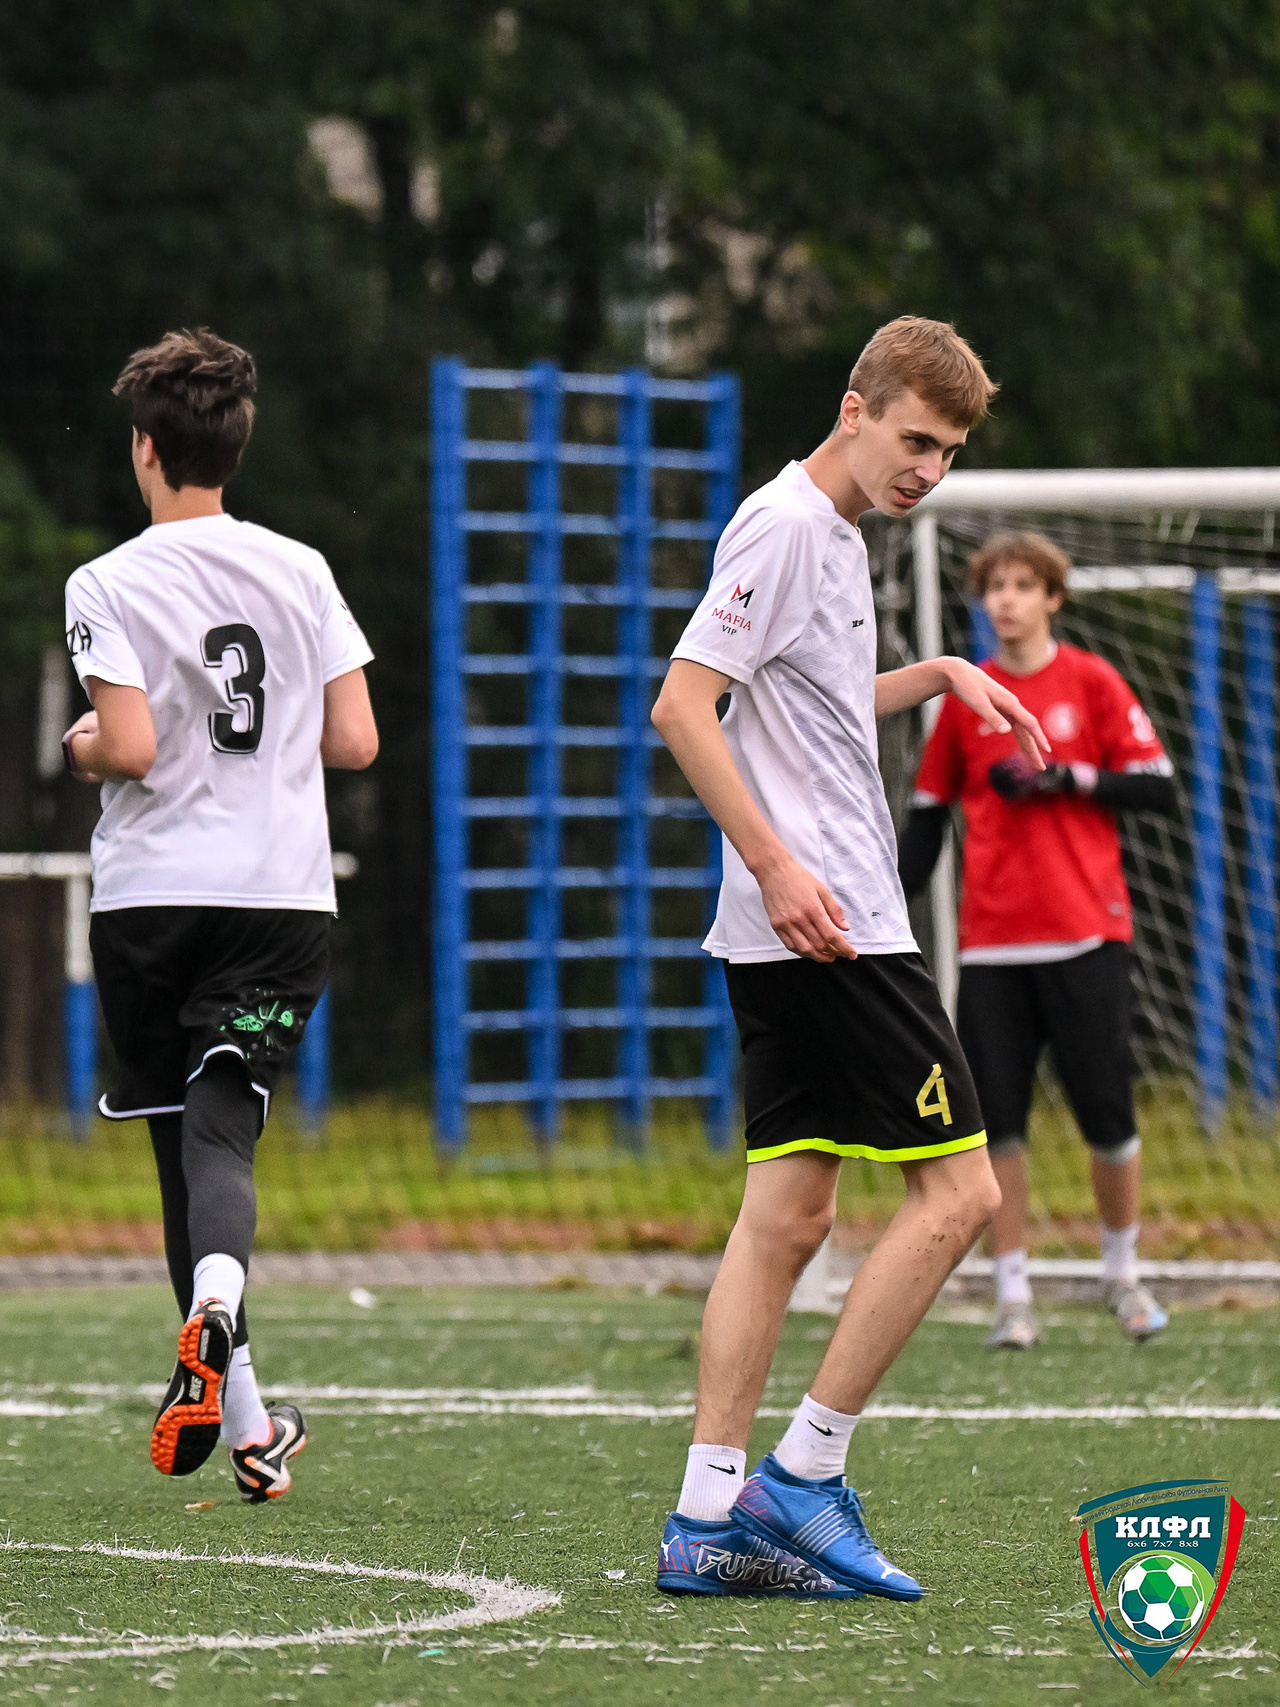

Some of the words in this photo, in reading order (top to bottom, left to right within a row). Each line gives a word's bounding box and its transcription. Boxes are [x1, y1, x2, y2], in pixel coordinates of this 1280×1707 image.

[711, 607, 751, 631] MAFIA
[722, 624, 737, 635] VIP
[200, 623, 265, 754] 3
[915, 1063, 953, 1126] 4
